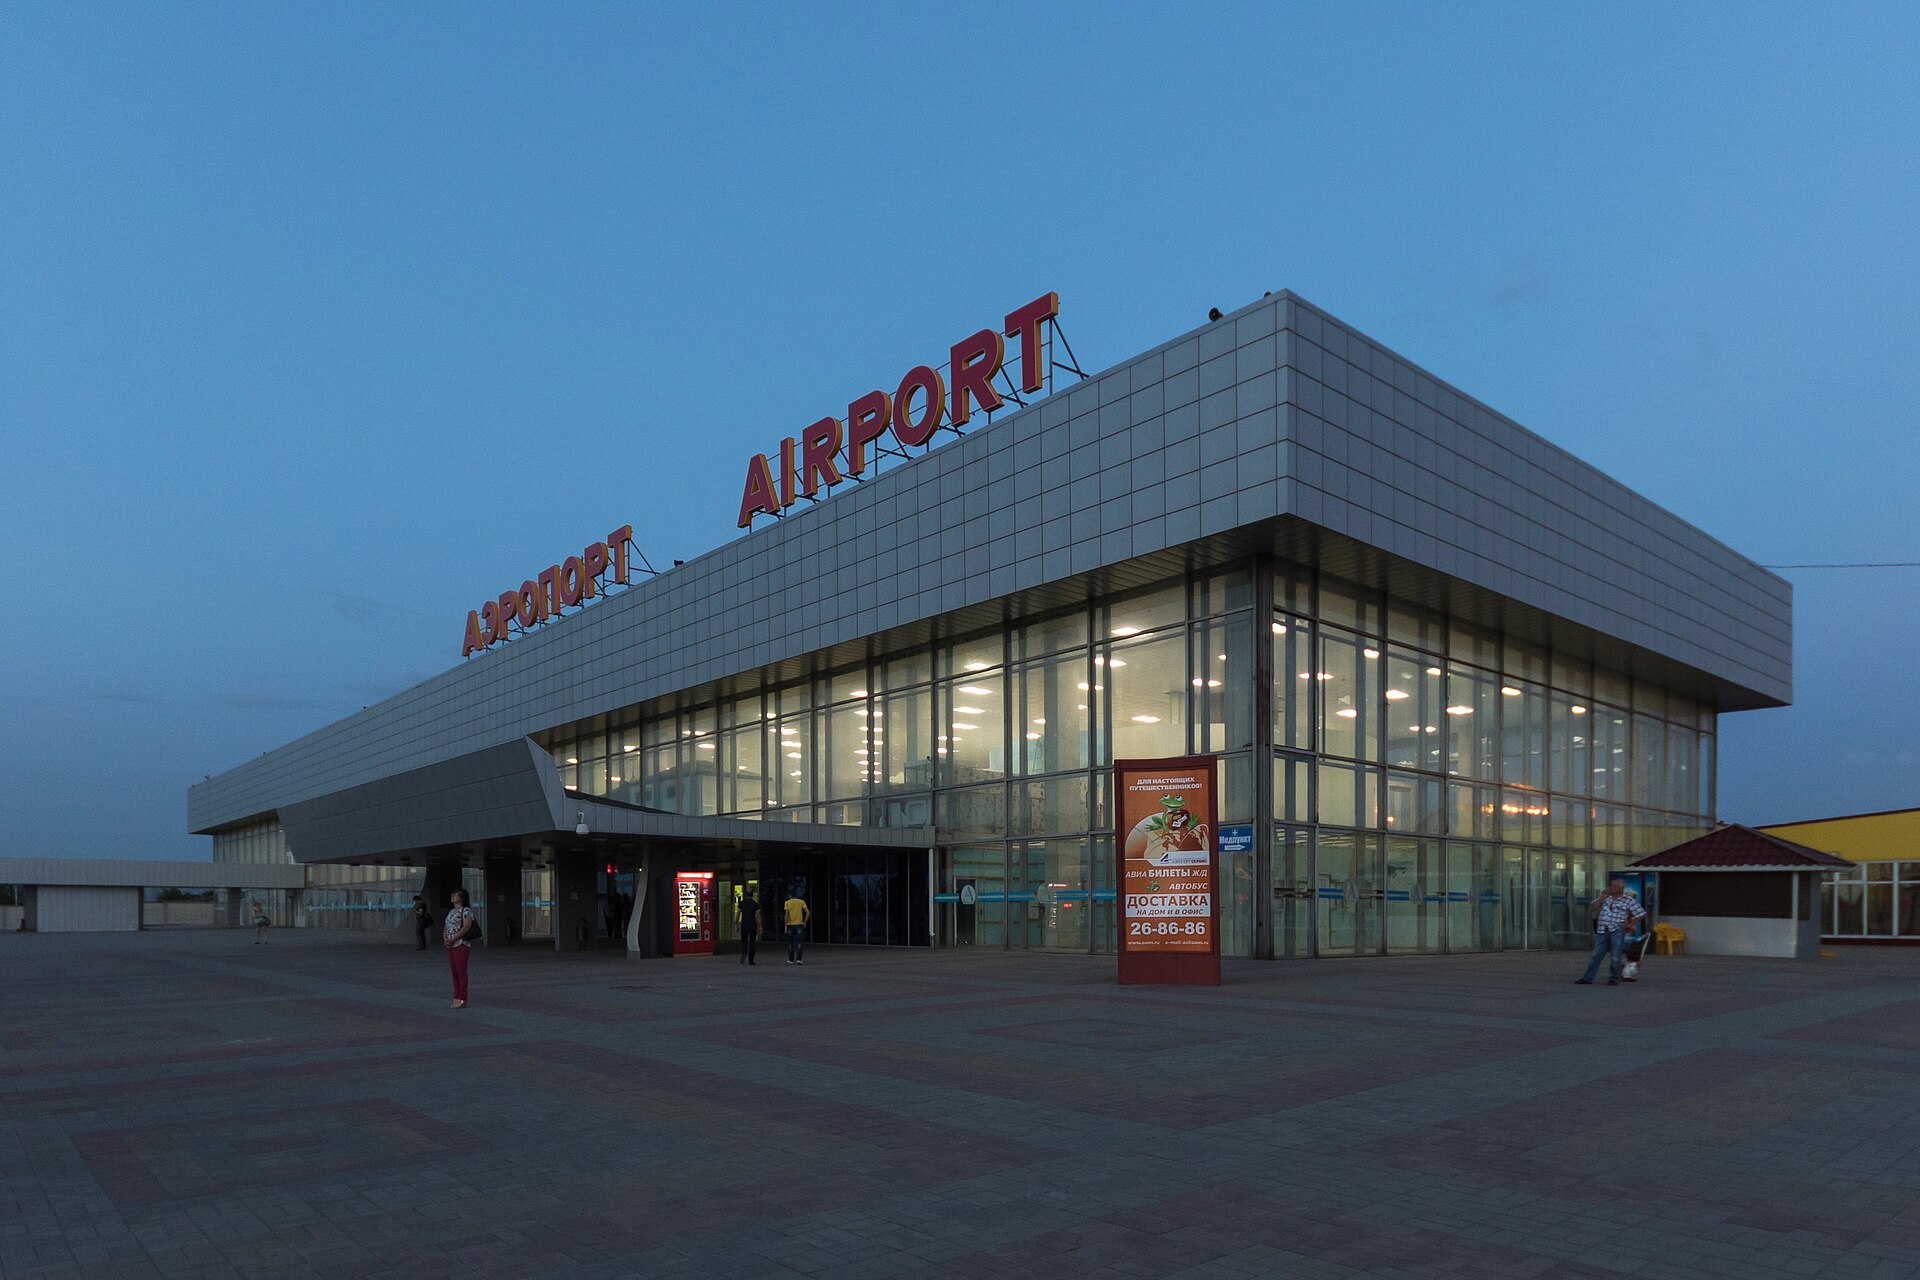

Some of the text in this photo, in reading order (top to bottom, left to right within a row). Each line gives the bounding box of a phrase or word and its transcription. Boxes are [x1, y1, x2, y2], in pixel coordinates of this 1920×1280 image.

[737, 291, 1059, 529] AIRPORT
[461, 524, 633, 657] АЭРОПОРТ
[1152, 776, 1195, 784] НАСТОЯЩИХ
[1219, 835, 1251, 845] Медпункт
[1148, 868, 1190, 878] БИЛЕТЫ
[1191, 869, 1208, 877] Ж/Д
[1168, 882, 1208, 890] АВТОБУС
[1127, 895, 1208, 909] ДОСТАВКА
[1130, 921, 1206, 936] 26-86-86
